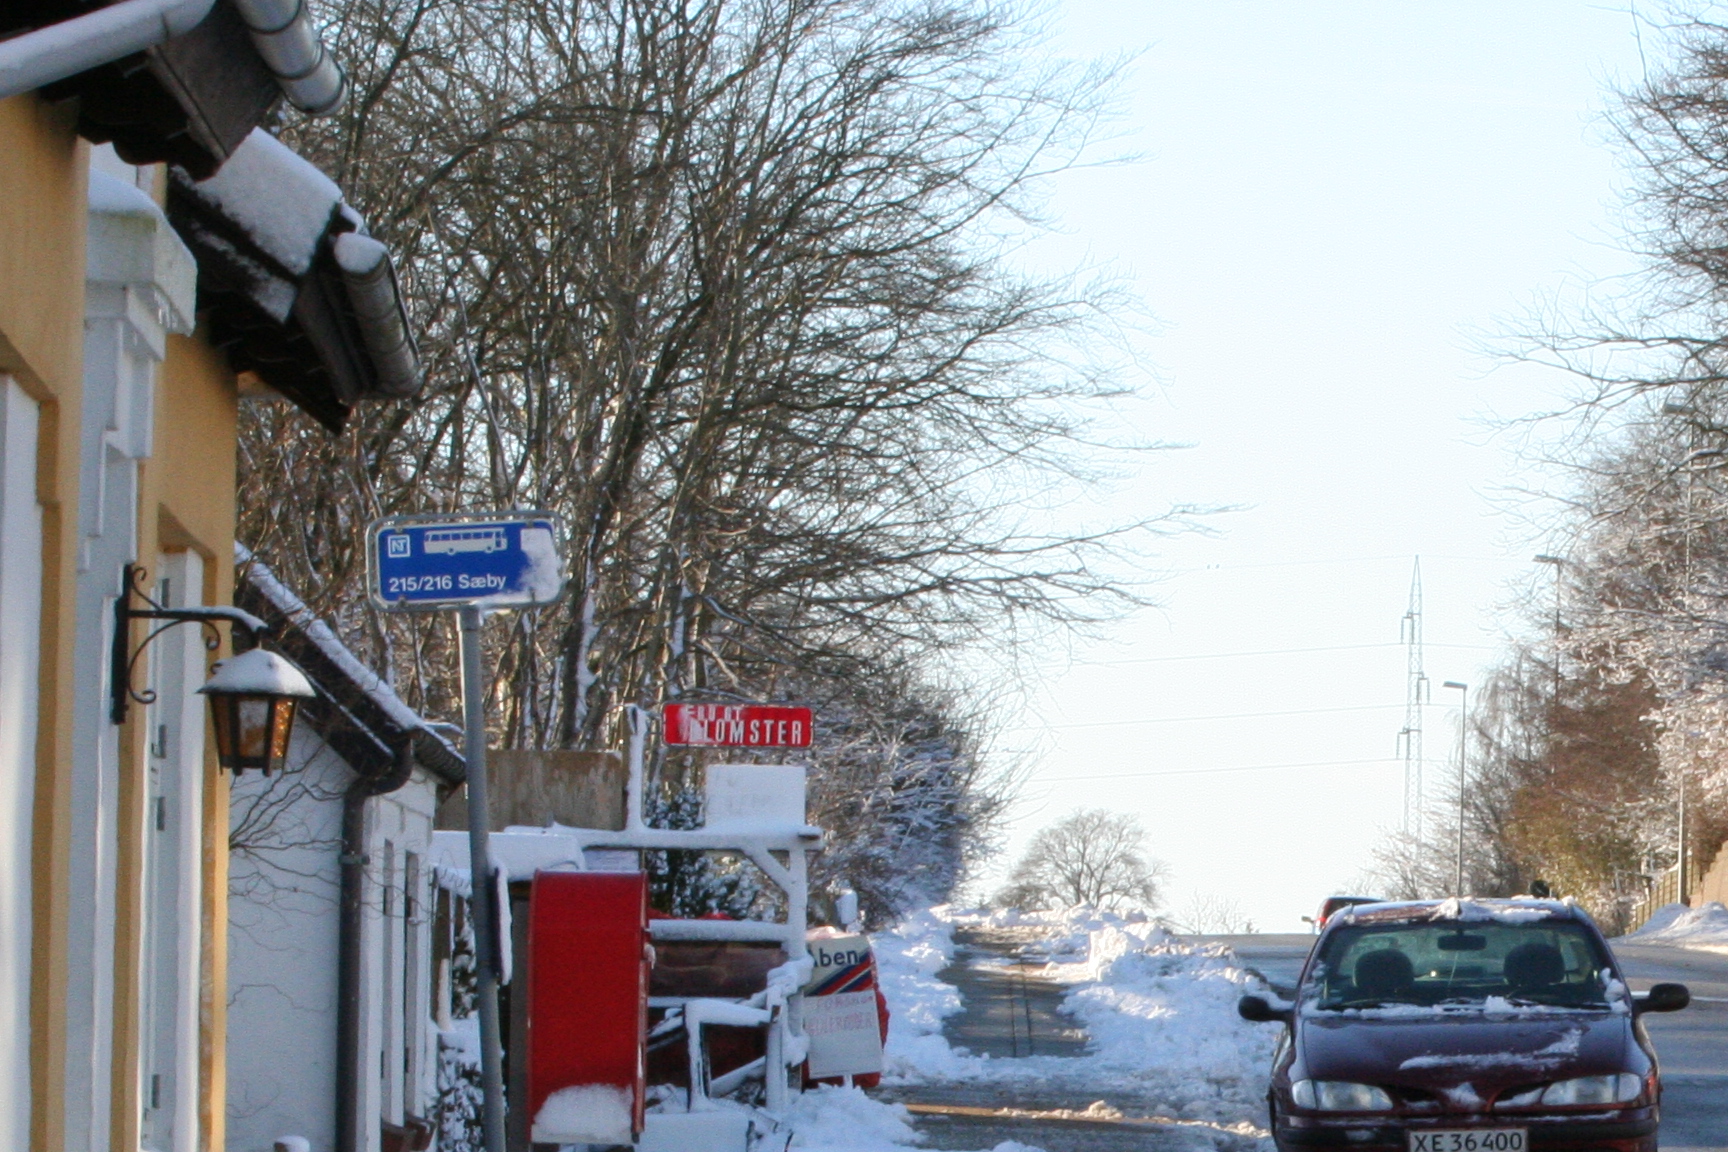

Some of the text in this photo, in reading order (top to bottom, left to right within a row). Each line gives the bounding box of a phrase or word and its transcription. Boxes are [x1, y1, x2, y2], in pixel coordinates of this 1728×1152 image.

[389, 573, 507, 592] 215/216 Sæby
[689, 718, 802, 745] LOMSTER
[1414, 1134, 1445, 1152] XE
